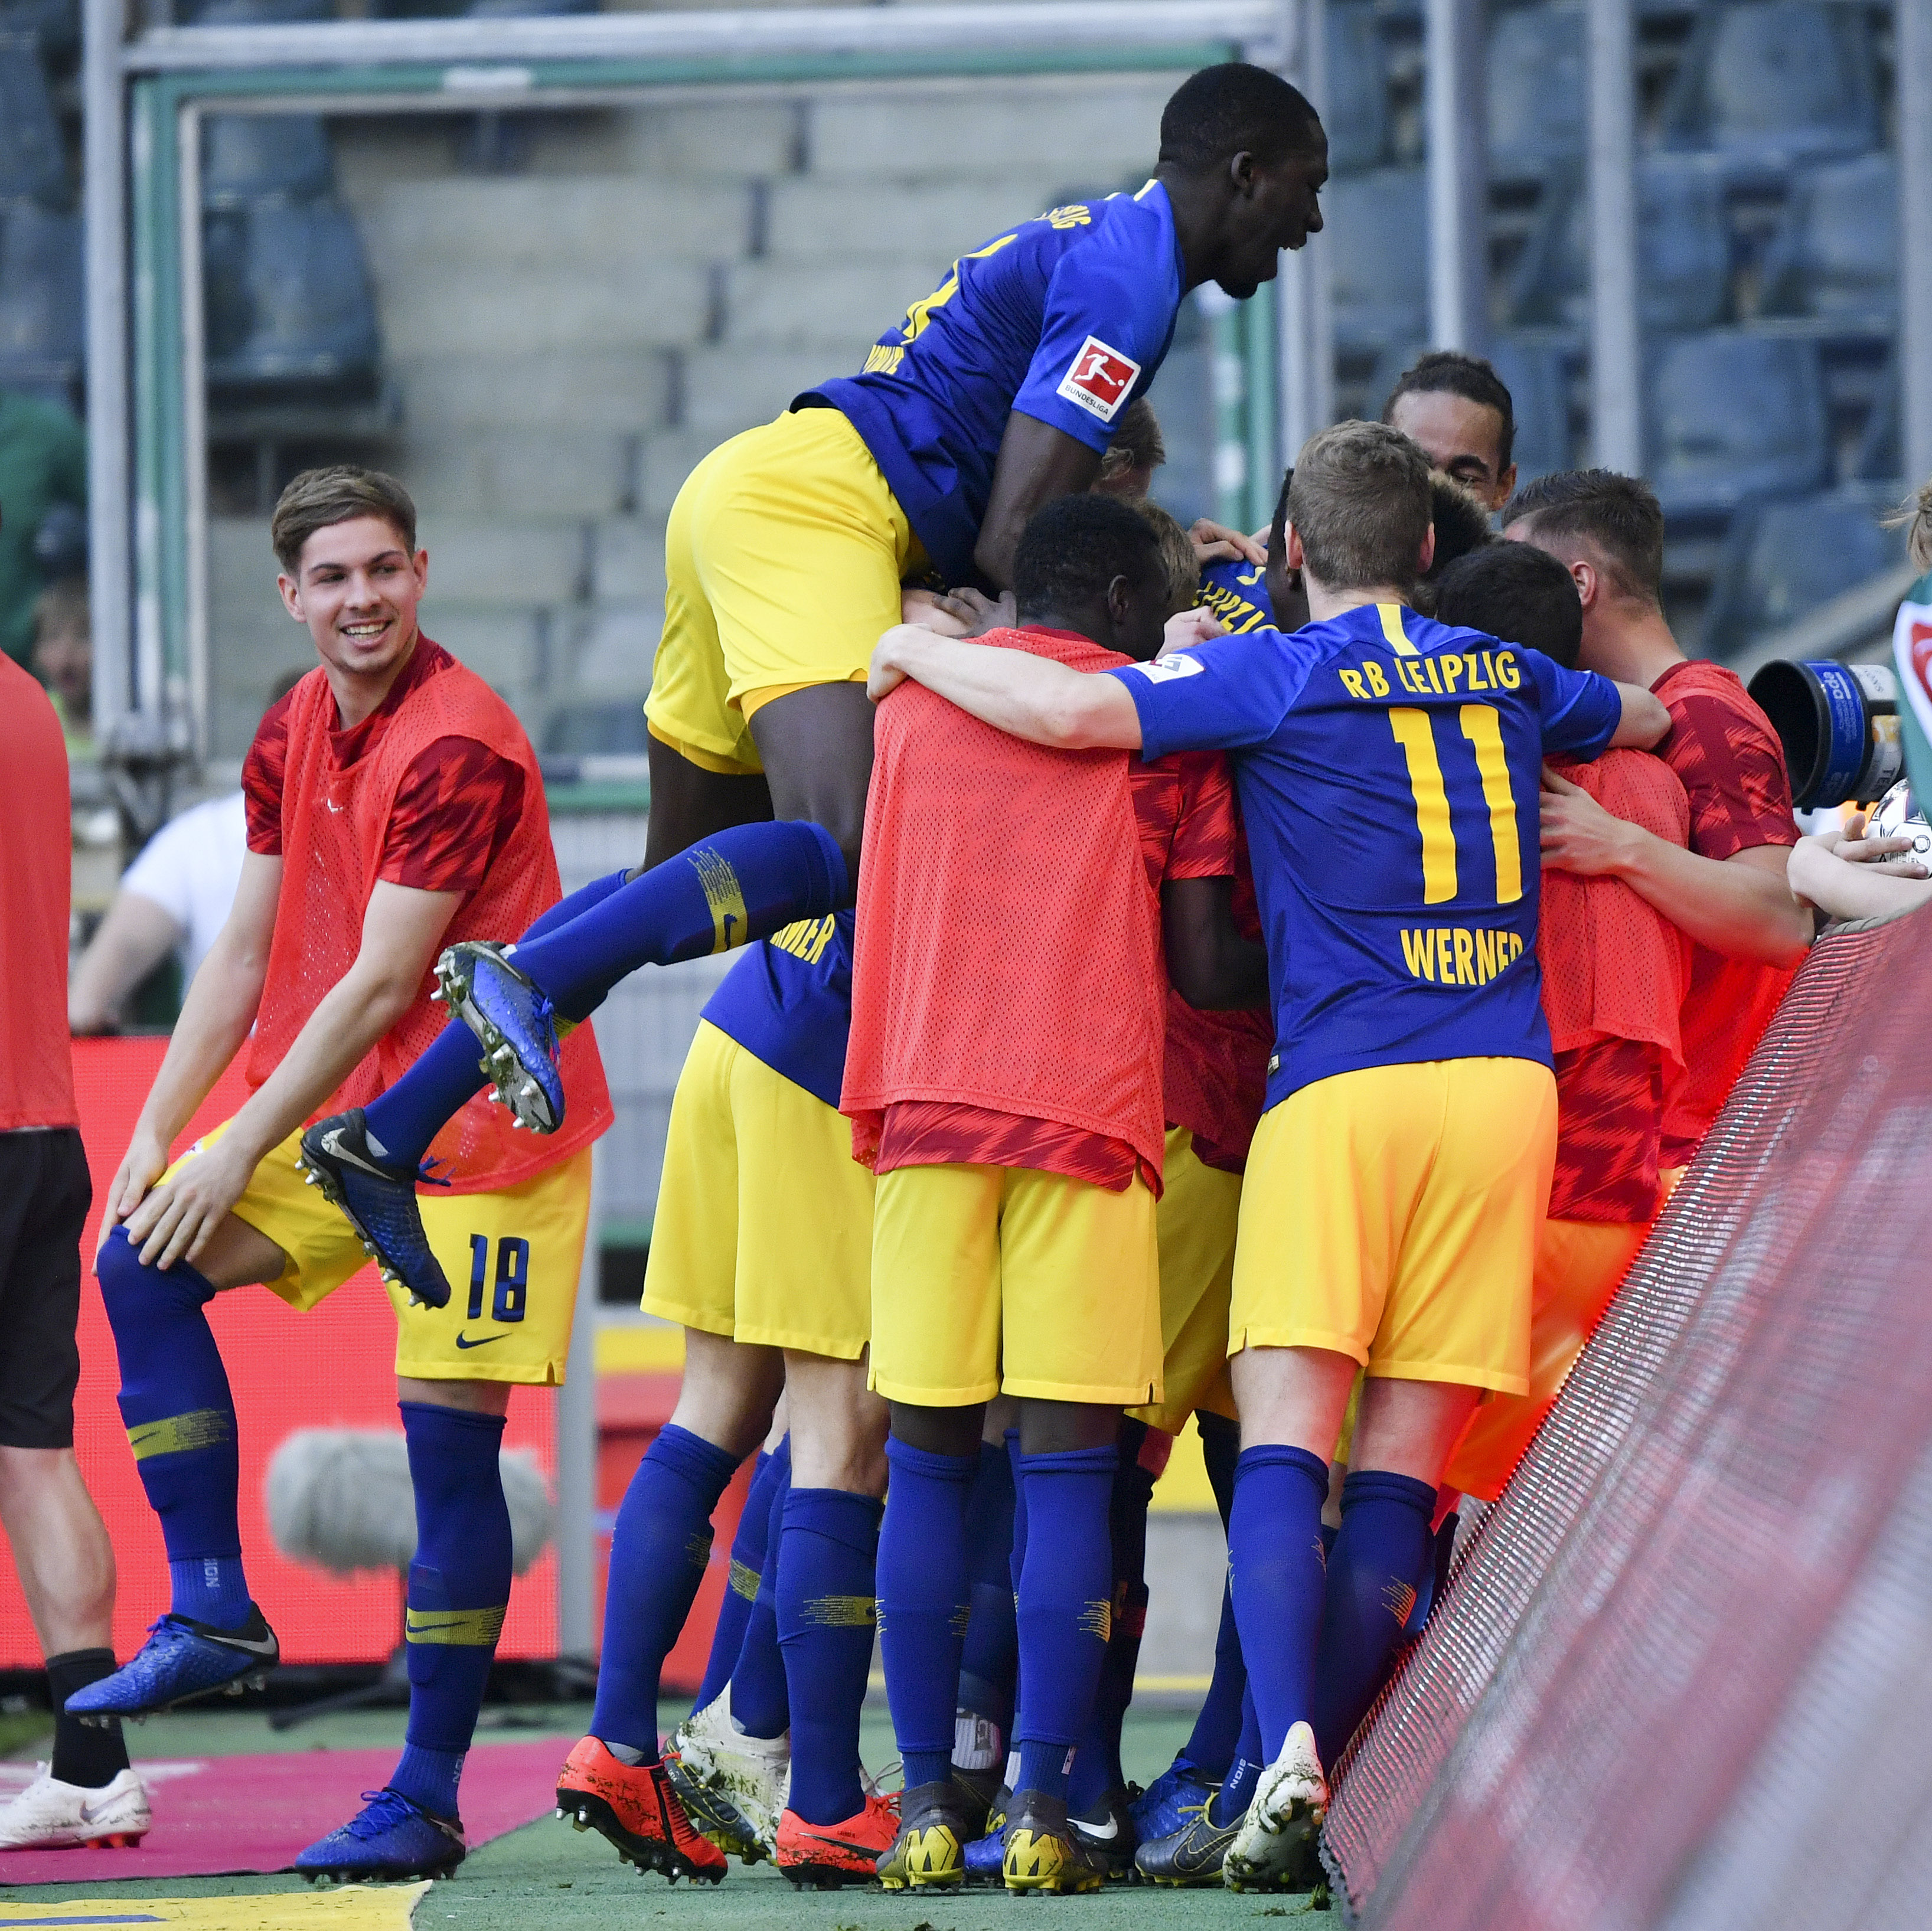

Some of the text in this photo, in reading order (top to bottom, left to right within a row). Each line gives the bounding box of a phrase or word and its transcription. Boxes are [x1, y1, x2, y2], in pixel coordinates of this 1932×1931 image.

[1065, 384, 1109, 415] BUNDESLIGA
[1338, 651, 1521, 700] RB LEIPZIG
[1389, 704, 1523, 905] 11
[466, 1233, 530, 1322] 18
